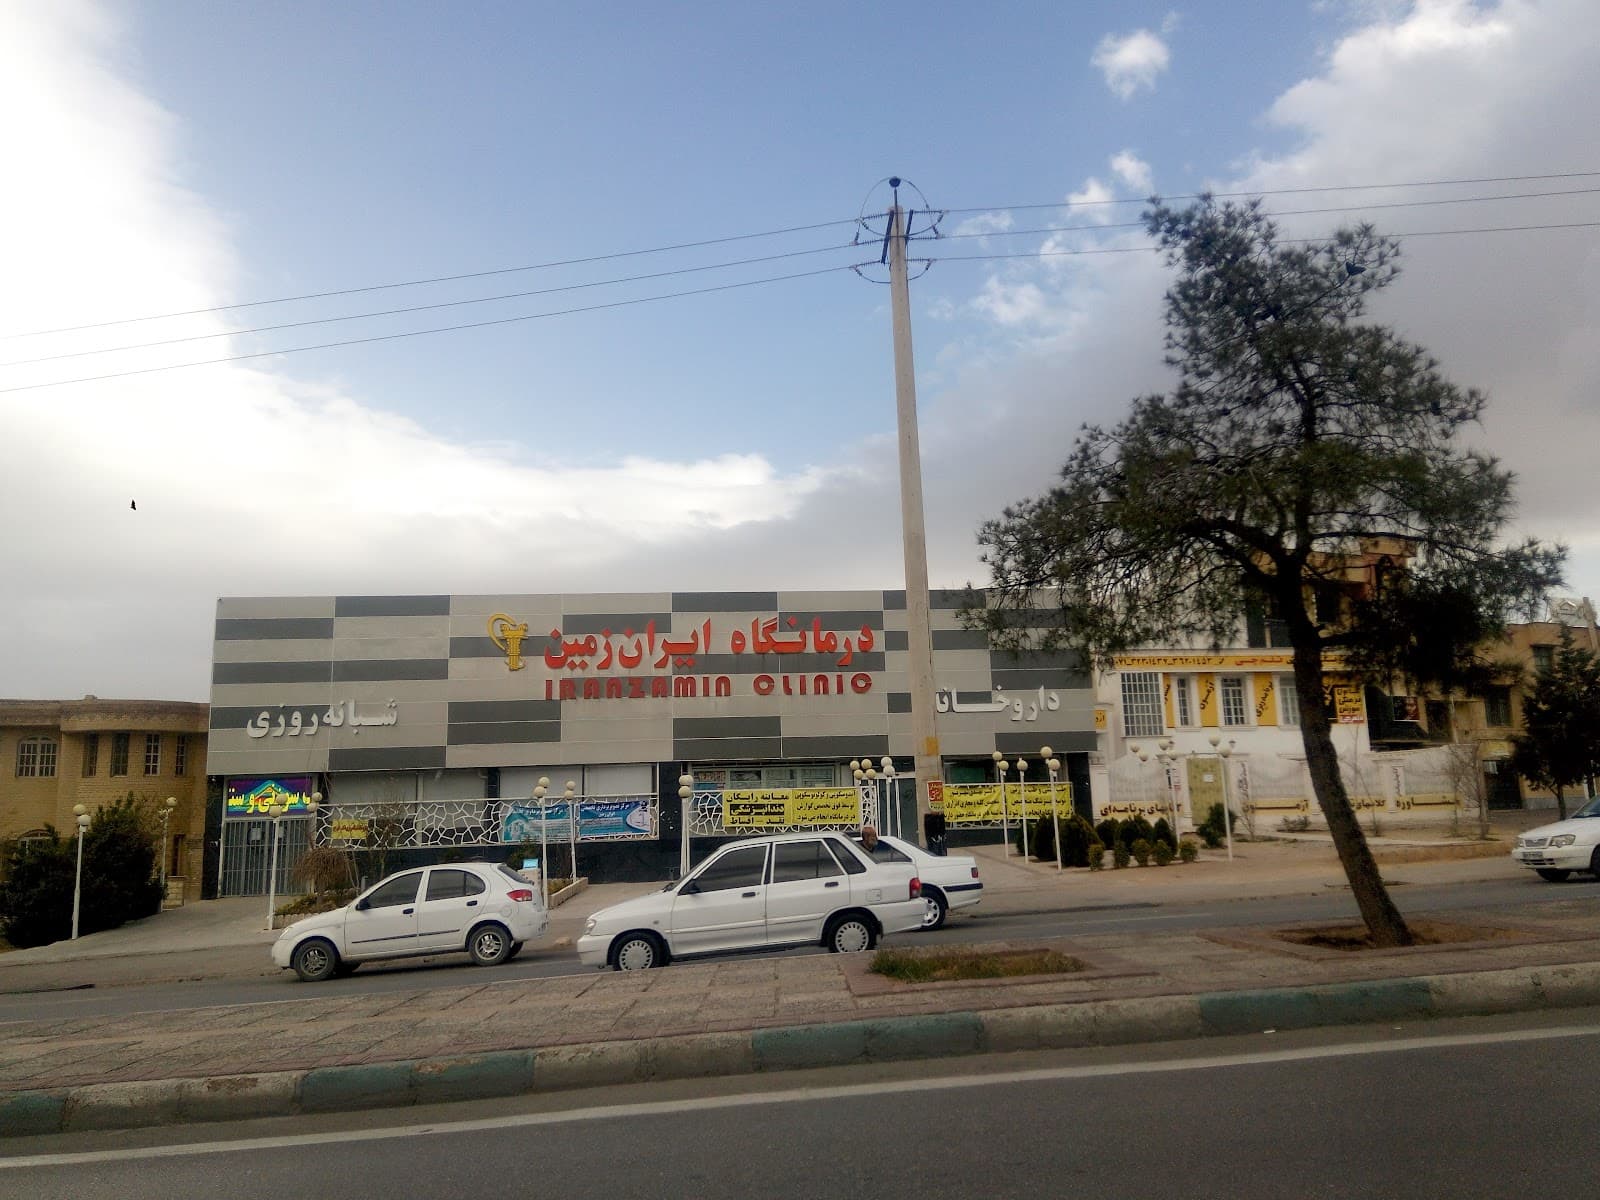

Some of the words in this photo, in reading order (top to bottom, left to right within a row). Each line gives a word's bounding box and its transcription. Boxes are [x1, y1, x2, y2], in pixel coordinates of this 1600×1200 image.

[545, 628, 613, 670] زمین
[619, 616, 711, 669] ایران
[731, 616, 874, 667] درمانگاه
[546, 676, 731, 700] IRANZAMIN
[754, 673, 872, 696] CLINIC
[936, 685, 1060, 721] داروخان
[247, 704, 319, 738] روزی
[323, 698, 398, 735] شبانه
[727, 792, 759, 803] رایگان
[731, 804, 785, 816] دندانپزشکی
[761, 792, 789, 802] معاینه
